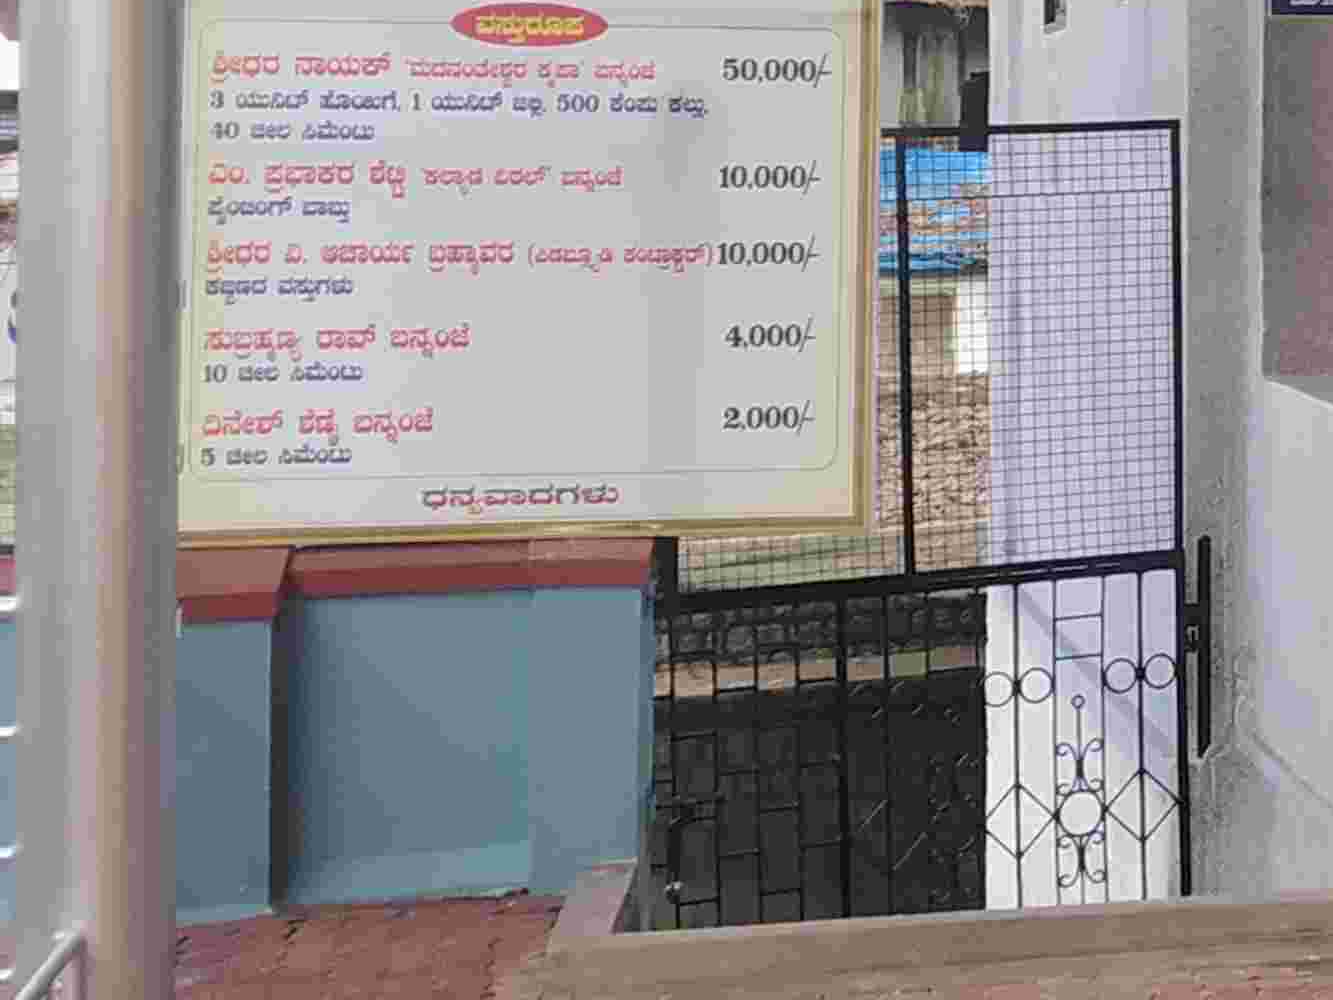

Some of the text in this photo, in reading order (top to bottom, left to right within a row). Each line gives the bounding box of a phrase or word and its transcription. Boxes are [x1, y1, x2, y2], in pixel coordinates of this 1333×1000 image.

[721, 53, 834, 89] 50,000/-
[209, 89, 226, 109] 3
[410, 91, 422, 111] 1
[556, 93, 601, 113] 500
[718, 159, 822, 198] 10,000/-
[717, 232, 822, 273] 10,000/-
[315, 323, 377, 351] ರಾವ್
[723, 315, 817, 353] 4,000/-
[202, 363, 228, 384] 10
[199, 446, 216, 467] 5
[421, 482, 621, 516] ಧನ್ಯವಾದಗಳು
